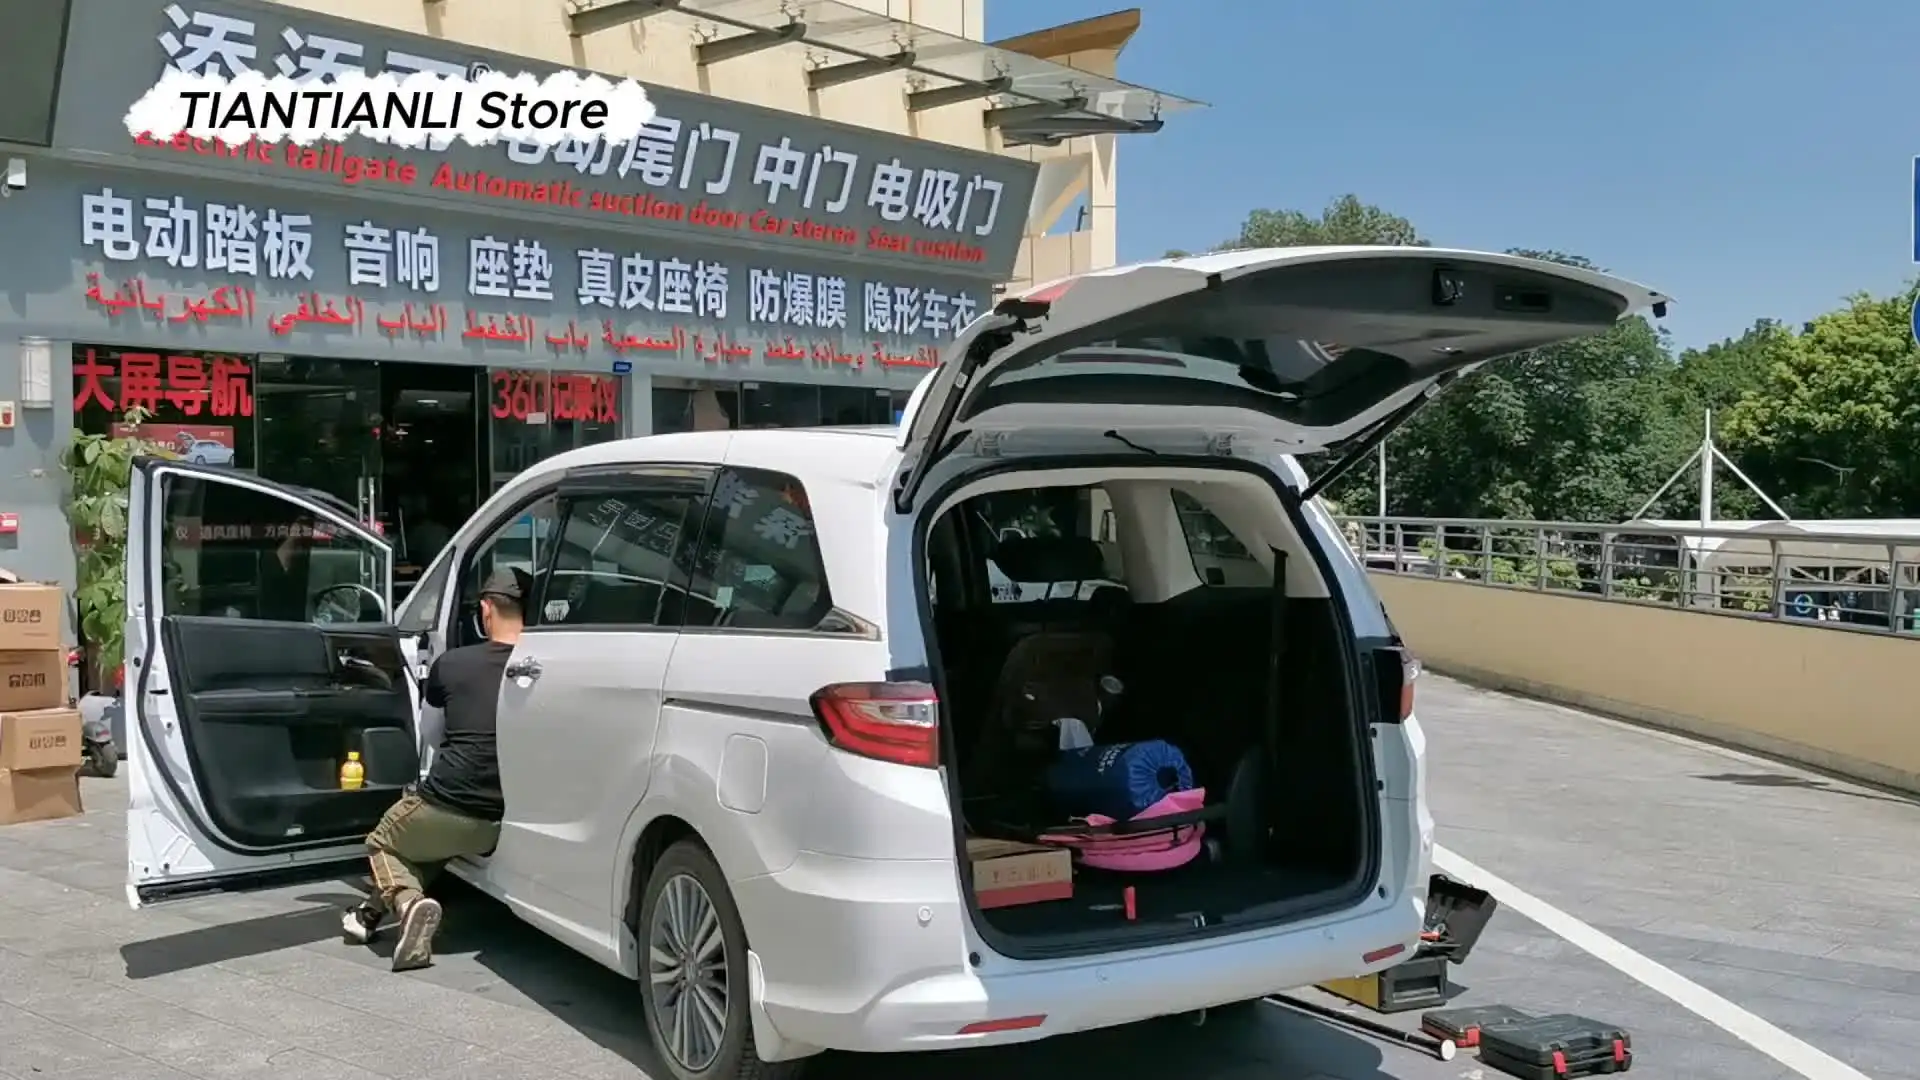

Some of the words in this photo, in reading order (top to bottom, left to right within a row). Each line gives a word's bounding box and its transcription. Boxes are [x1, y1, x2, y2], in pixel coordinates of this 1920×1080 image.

[283, 144, 418, 185] tailgate
[431, 161, 584, 207] Automatic
[590, 186, 684, 222] suction
[753, 137, 858, 213] 中门
[867, 158, 1004, 236] 电吸门
[82, 187, 315, 281] 电动踏板
[344, 220, 440, 293] 音响
[468, 235, 553, 300] 座垫
[576, 247, 729, 320] 真皮座椅
[749, 267, 848, 330] 防爆膜
[863, 281, 977, 339] 隐形车衣
[73, 349, 254, 416] 大屏导航
